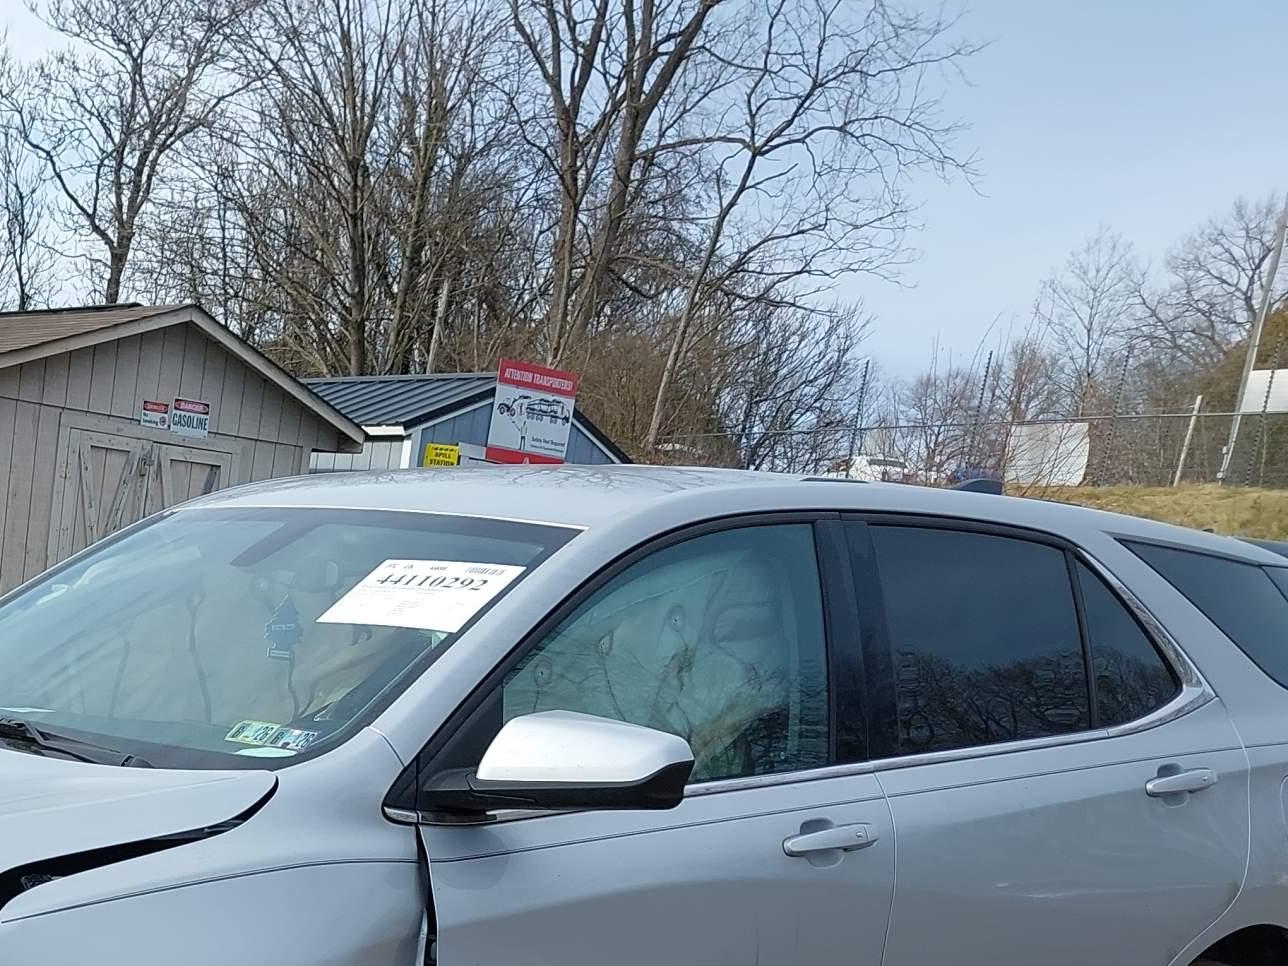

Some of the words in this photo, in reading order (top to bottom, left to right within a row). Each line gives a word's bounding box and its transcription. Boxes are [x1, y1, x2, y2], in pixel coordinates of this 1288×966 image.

[504, 368, 533, 382] ATTENTION
[172, 412, 208, 431] GASOLINE
[376, 573, 488, 591] 44110292
